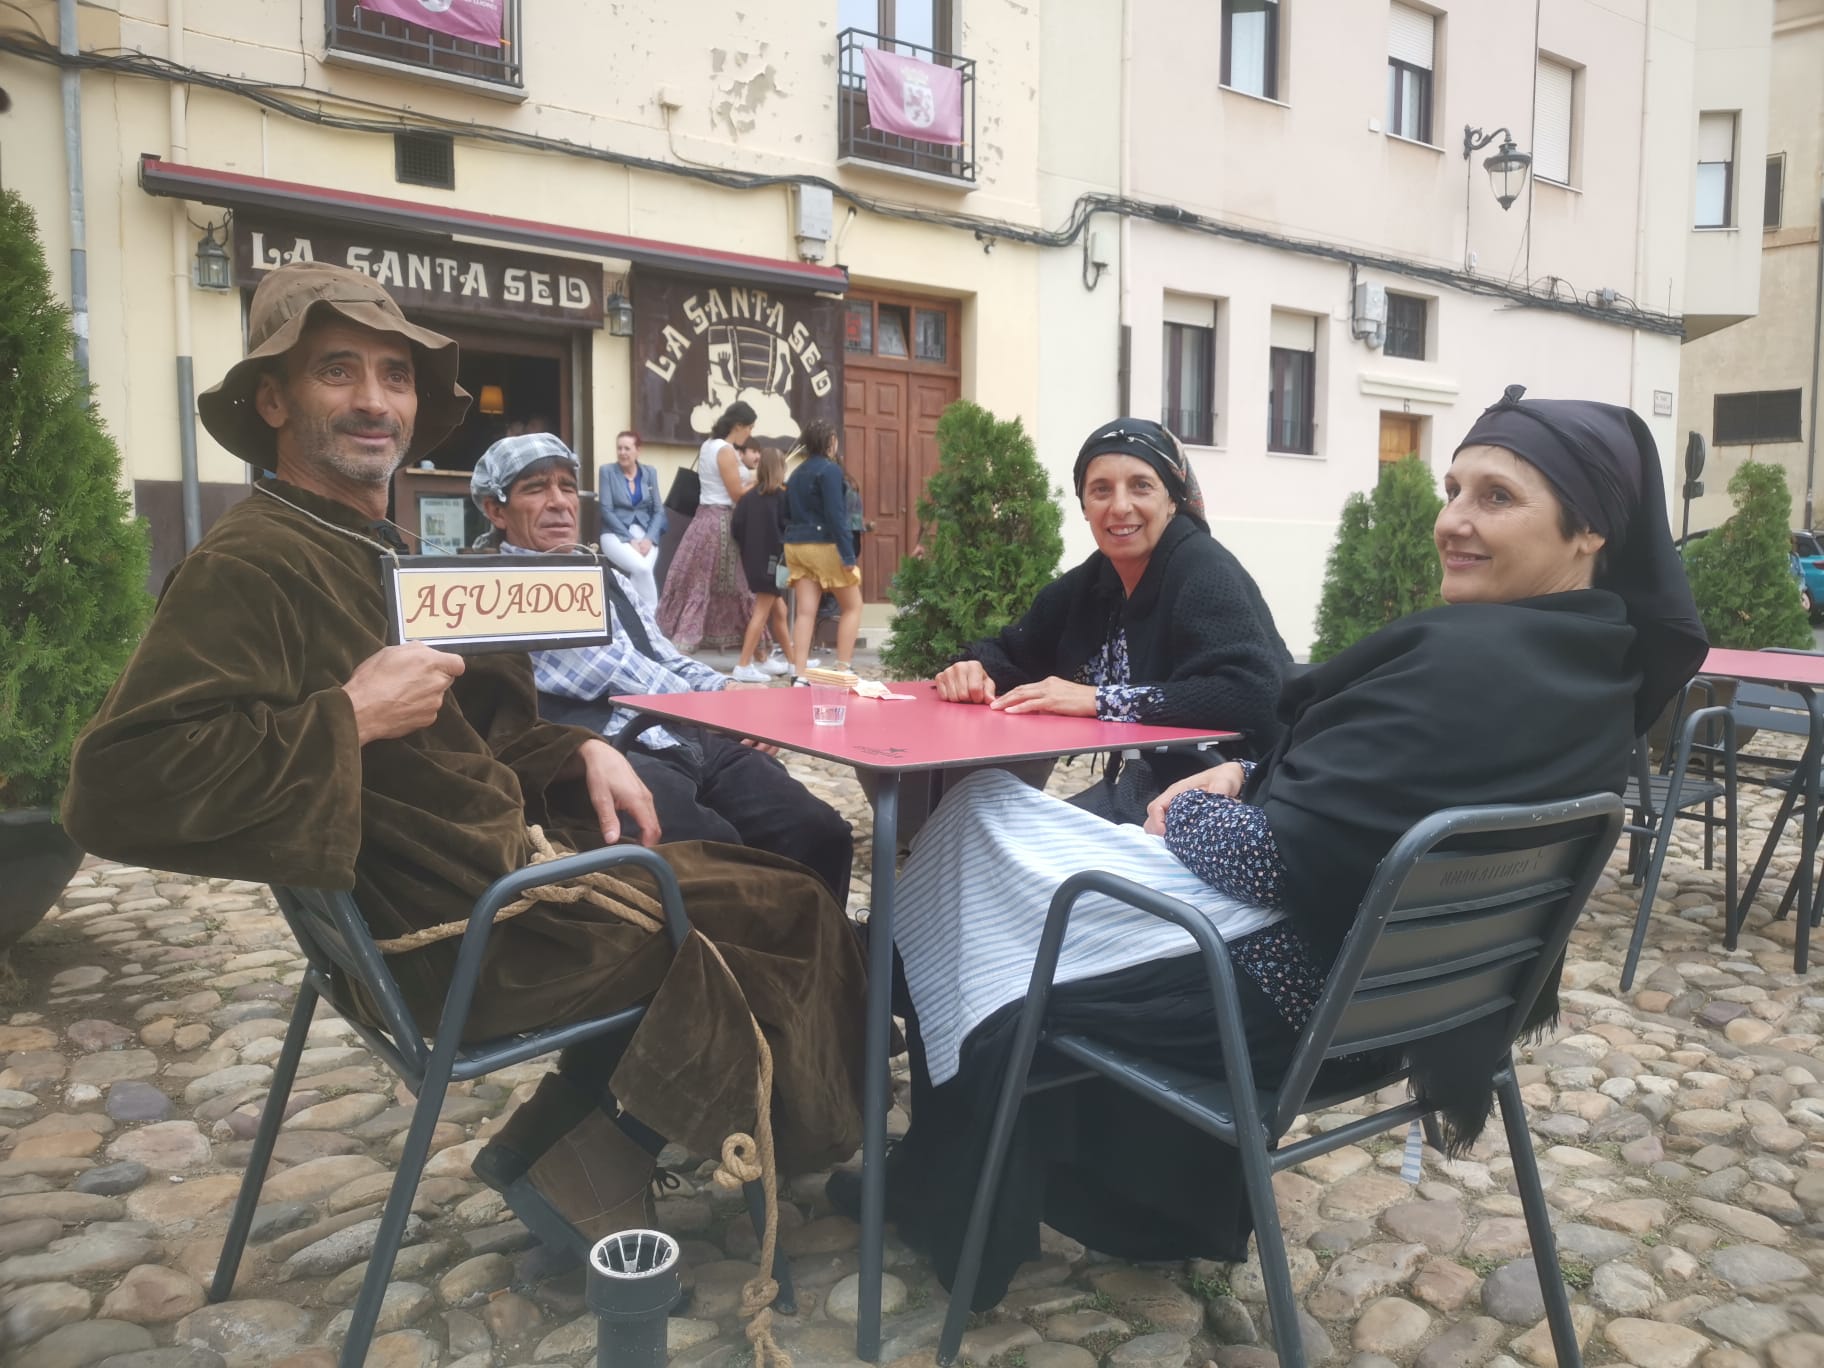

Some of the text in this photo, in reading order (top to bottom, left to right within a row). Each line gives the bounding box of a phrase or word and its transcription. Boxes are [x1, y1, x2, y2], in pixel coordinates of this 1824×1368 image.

[251, 232, 592, 310] LA SANTA SED
[645, 287, 832, 397] LA SANTA SED
[406, 579, 602, 629] AGUADOR
